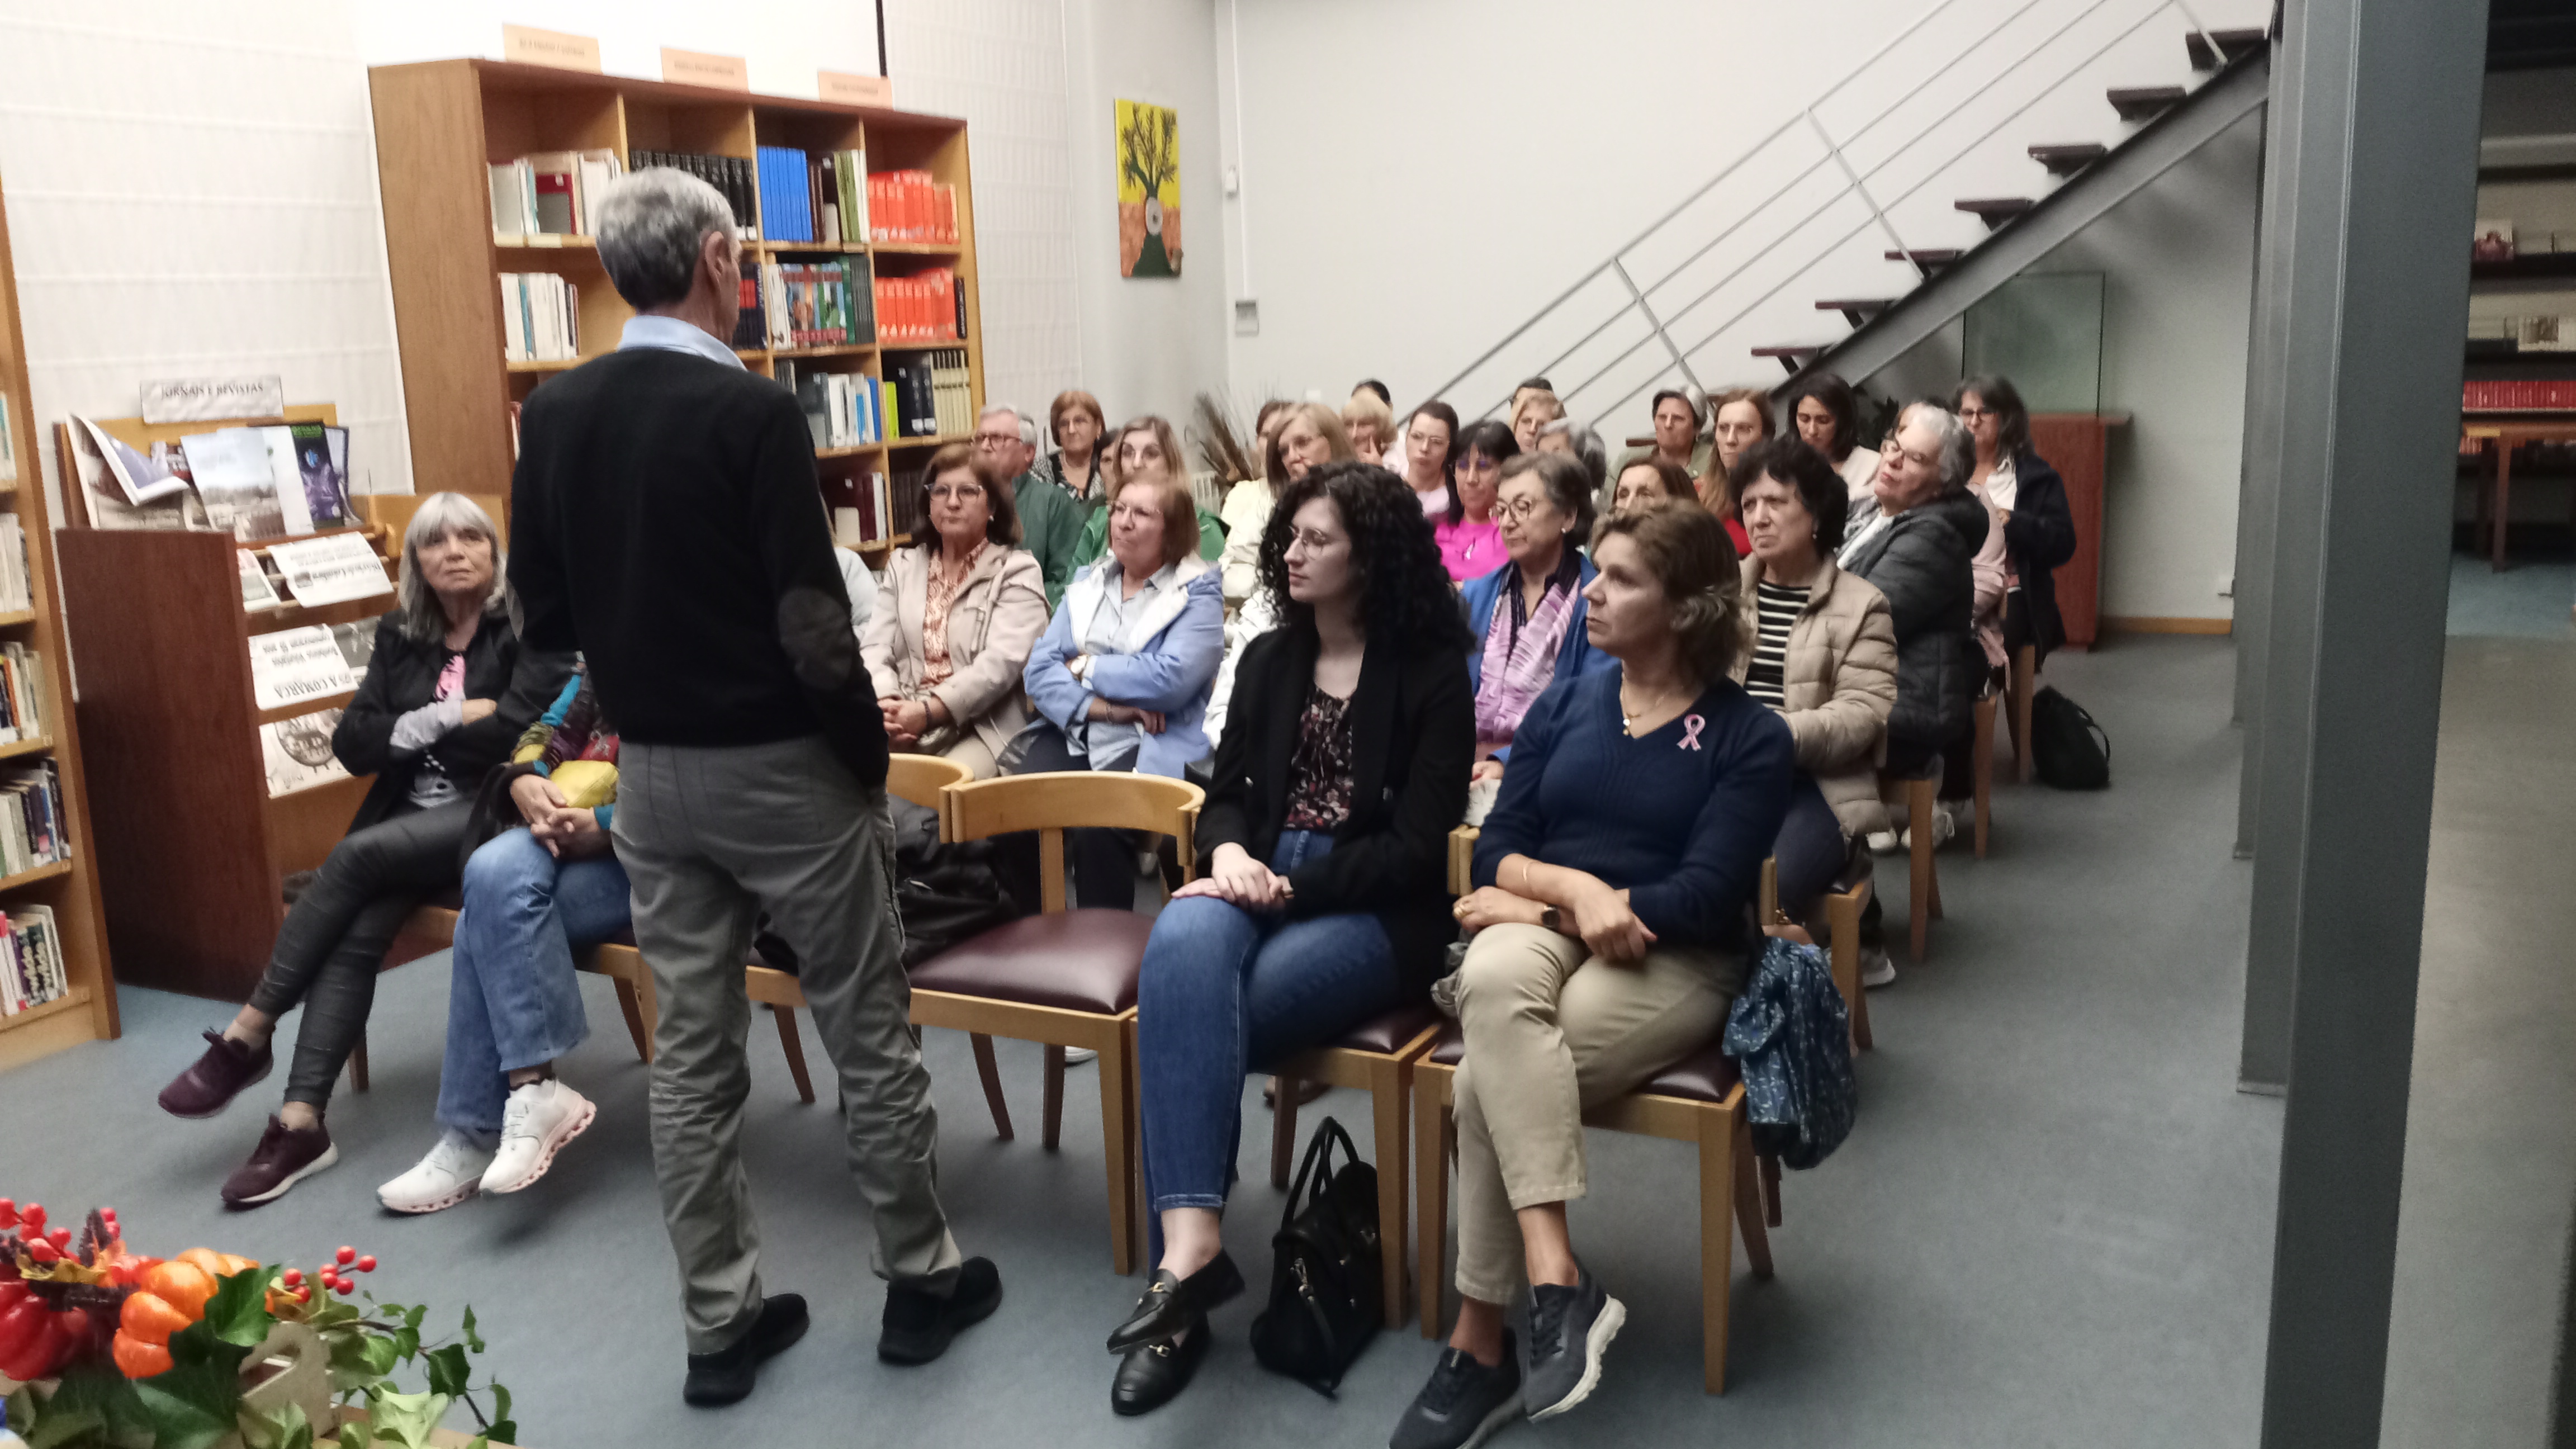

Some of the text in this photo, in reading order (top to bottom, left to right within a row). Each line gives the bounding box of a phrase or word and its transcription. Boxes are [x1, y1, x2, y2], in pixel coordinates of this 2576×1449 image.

[161, 384, 205, 399] JORNAIS
[216, 381, 264, 396] REVISTAS
[274, 679, 329, 699] COMARCA
